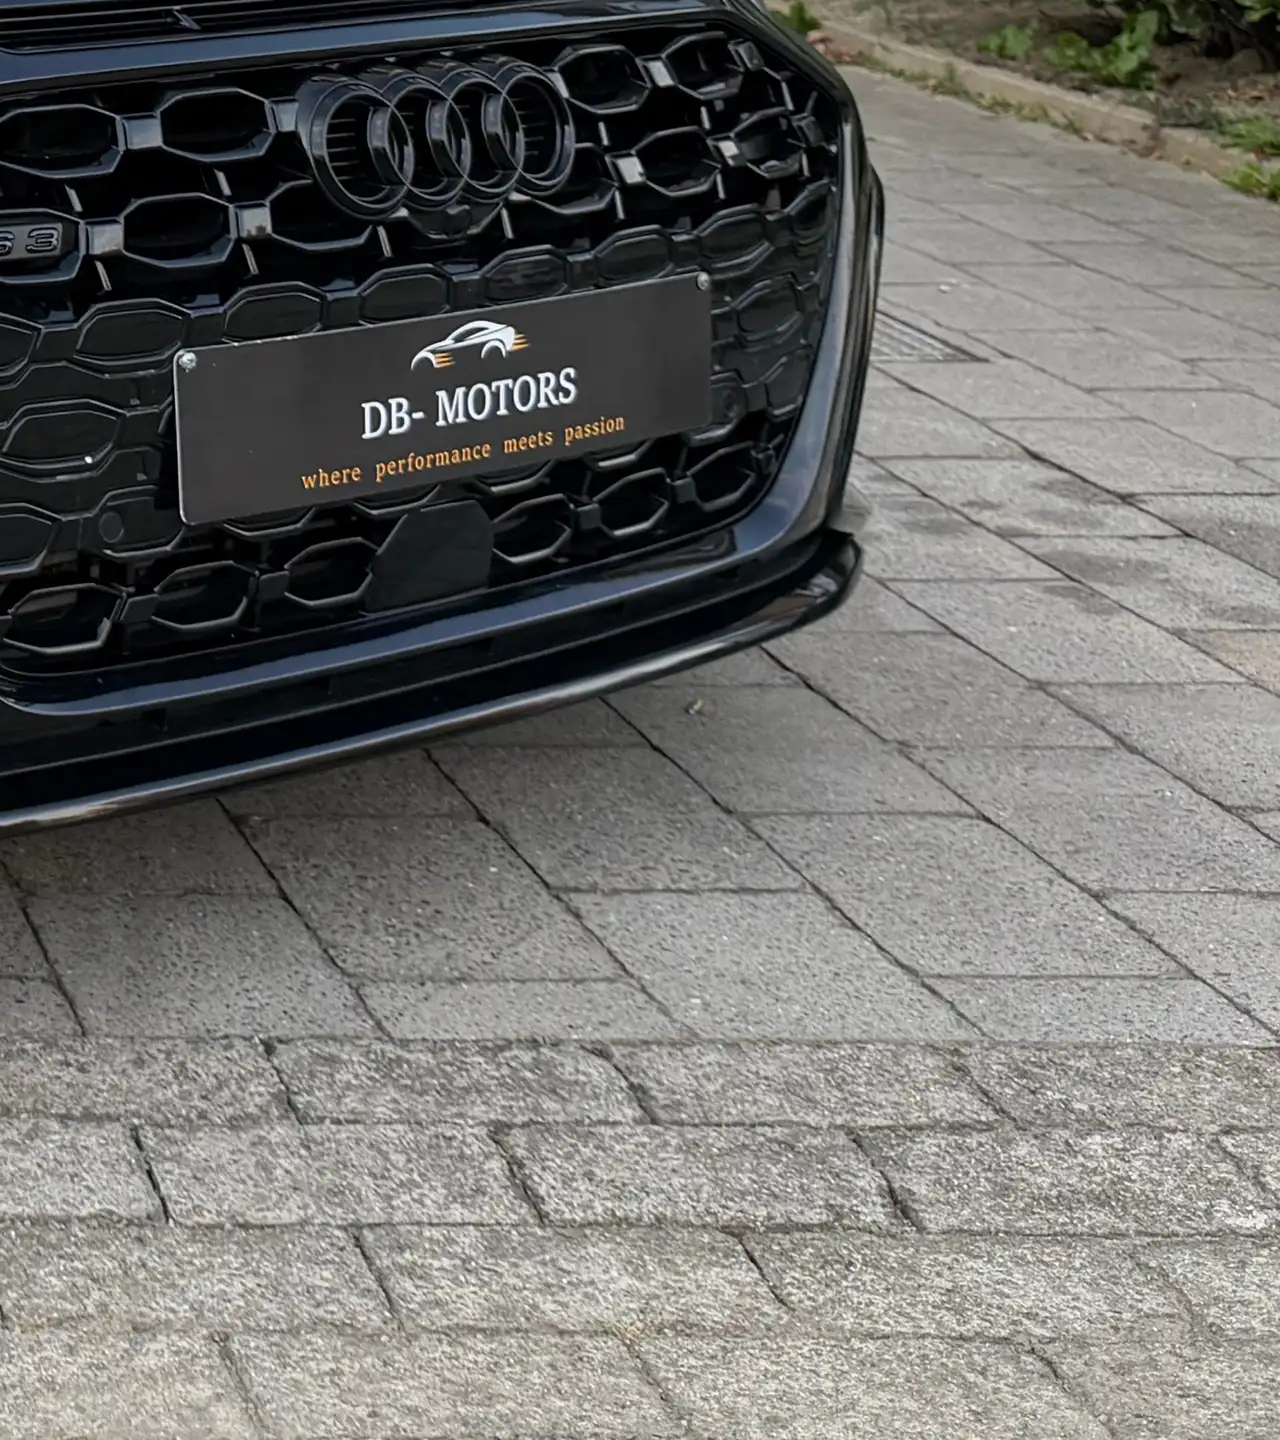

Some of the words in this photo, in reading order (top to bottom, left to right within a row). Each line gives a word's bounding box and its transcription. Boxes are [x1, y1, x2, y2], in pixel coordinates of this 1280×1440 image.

[25, 227, 60, 254] 3
[361, 396, 426, 440] DB-
[435, 367, 578, 428] MOTORS
[301, 465, 362, 490] where
[375, 442, 492, 482] performance
[503, 429, 554, 455] meets
[564, 414, 626, 447] passion
